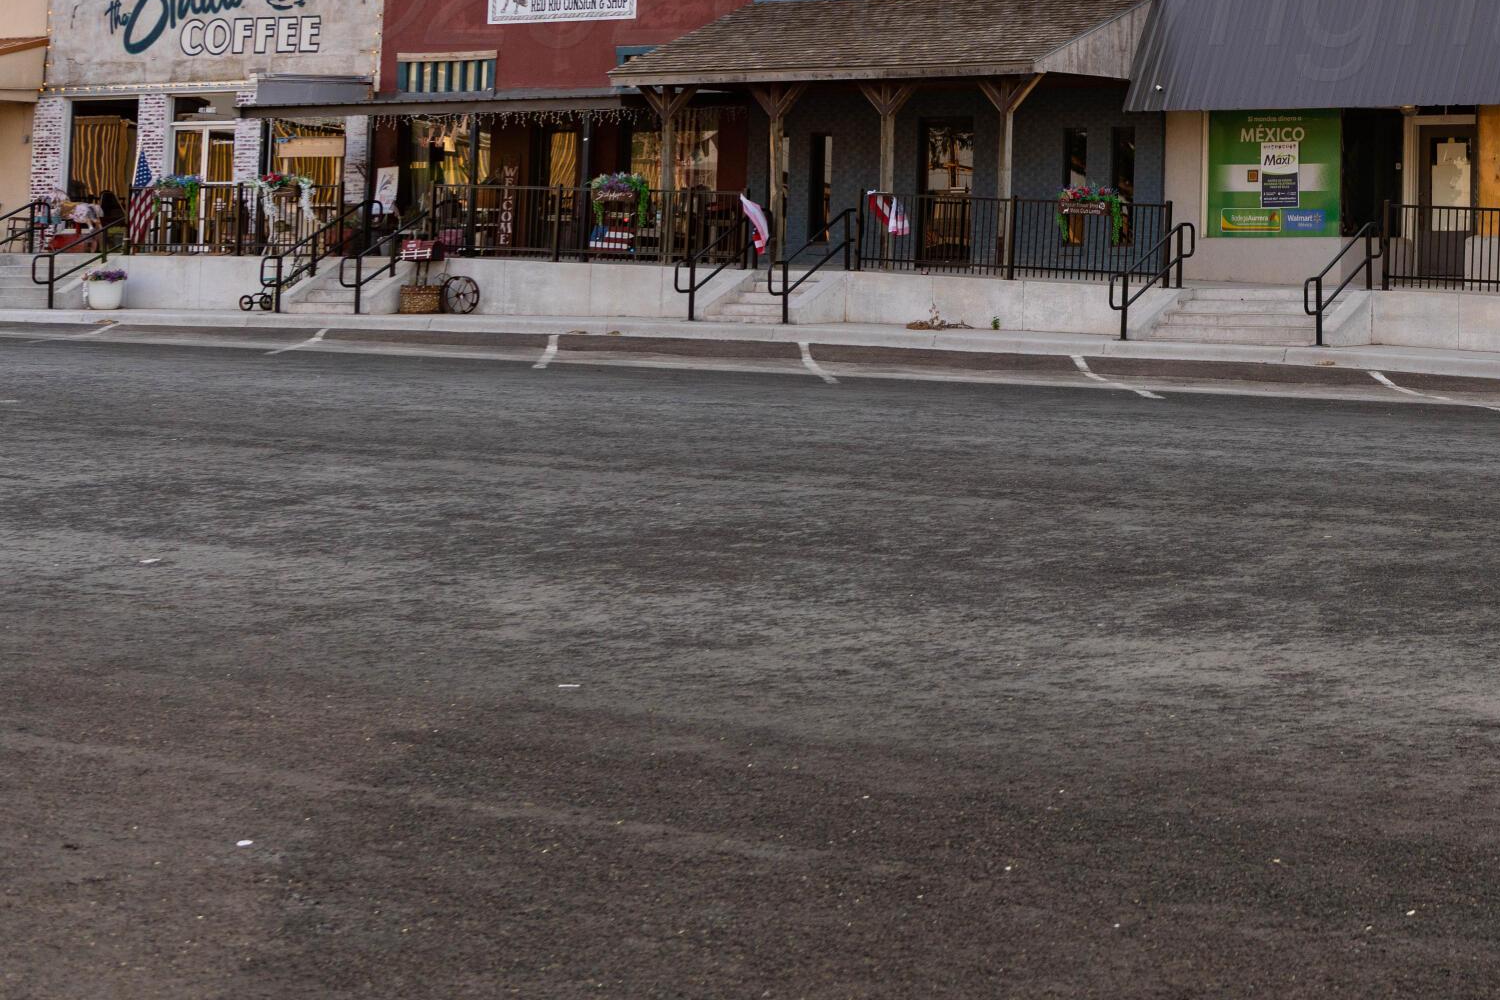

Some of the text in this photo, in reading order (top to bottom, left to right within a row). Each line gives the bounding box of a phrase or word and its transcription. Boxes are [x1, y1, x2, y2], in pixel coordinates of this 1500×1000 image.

[104, 0, 133, 35] the
[180, 15, 322, 56] COFFEE
[1240, 124, 1305, 142] MÉXICO
[1263, 154, 1291, 166] Maxi
[499, 165, 519, 245] WELCOME
[1287, 214, 1313, 222] Walmart
